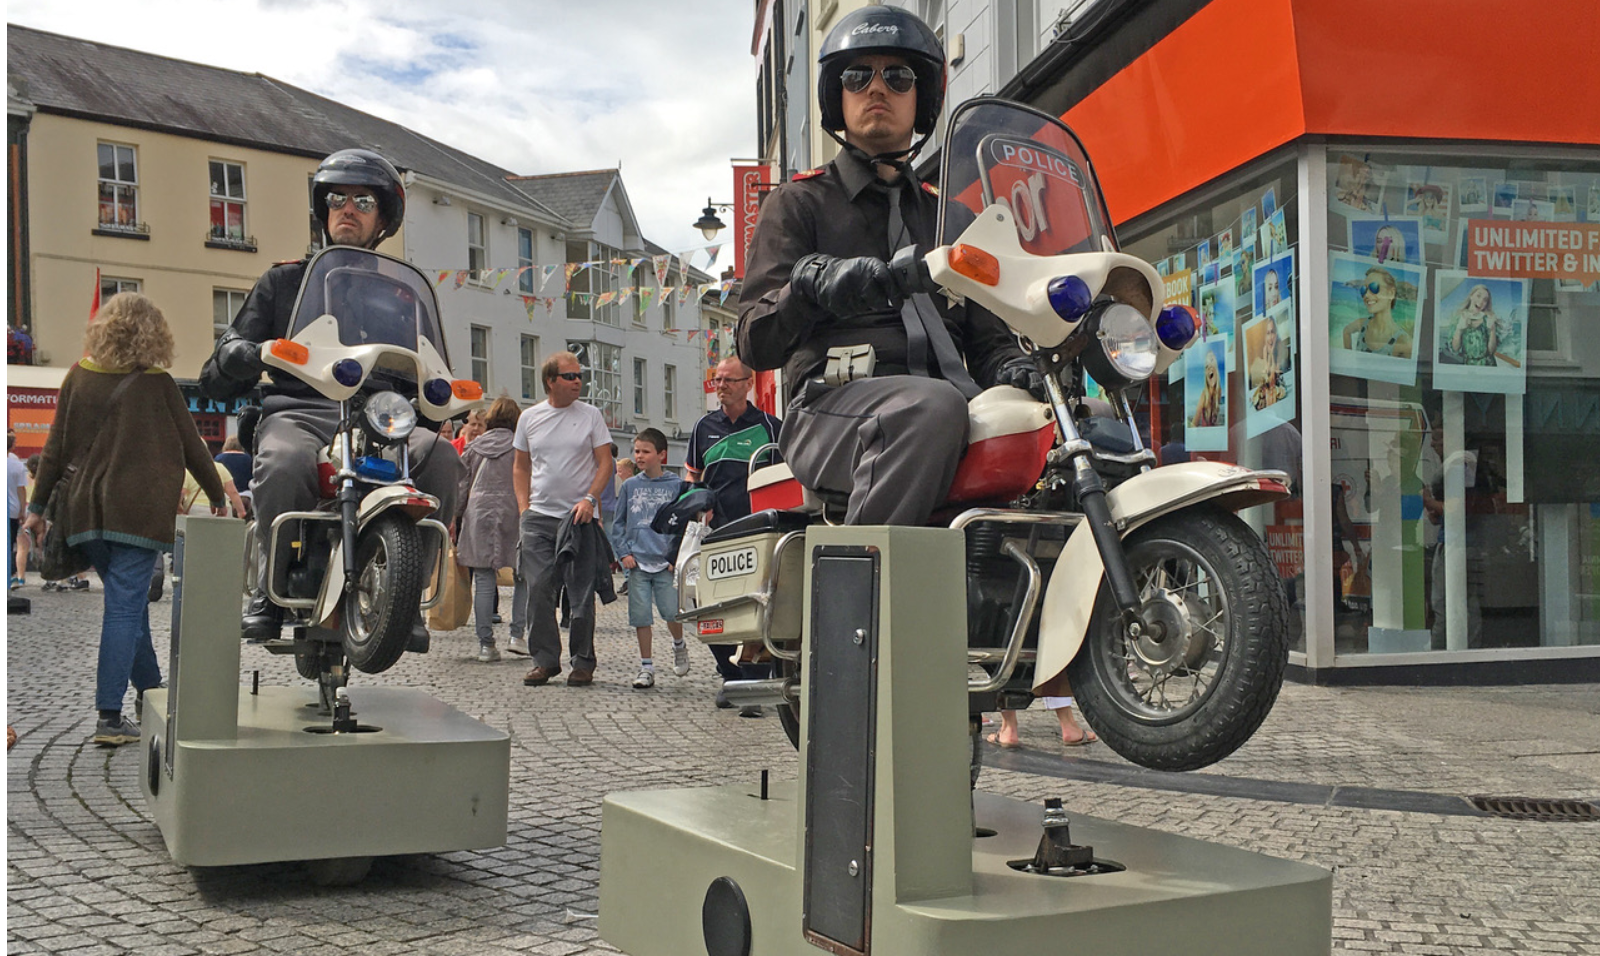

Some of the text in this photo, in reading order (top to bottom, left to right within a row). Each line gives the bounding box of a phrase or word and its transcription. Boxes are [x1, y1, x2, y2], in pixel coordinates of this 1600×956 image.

[852, 22, 898, 35] Caberg
[1003, 145, 1079, 182] POLICE
[1475, 227, 1582, 249] UNLIMITED
[1474, 250, 1558, 271] TWITTER
[1563, 253, 1578, 272] &
[711, 552, 753, 575] POLICE
